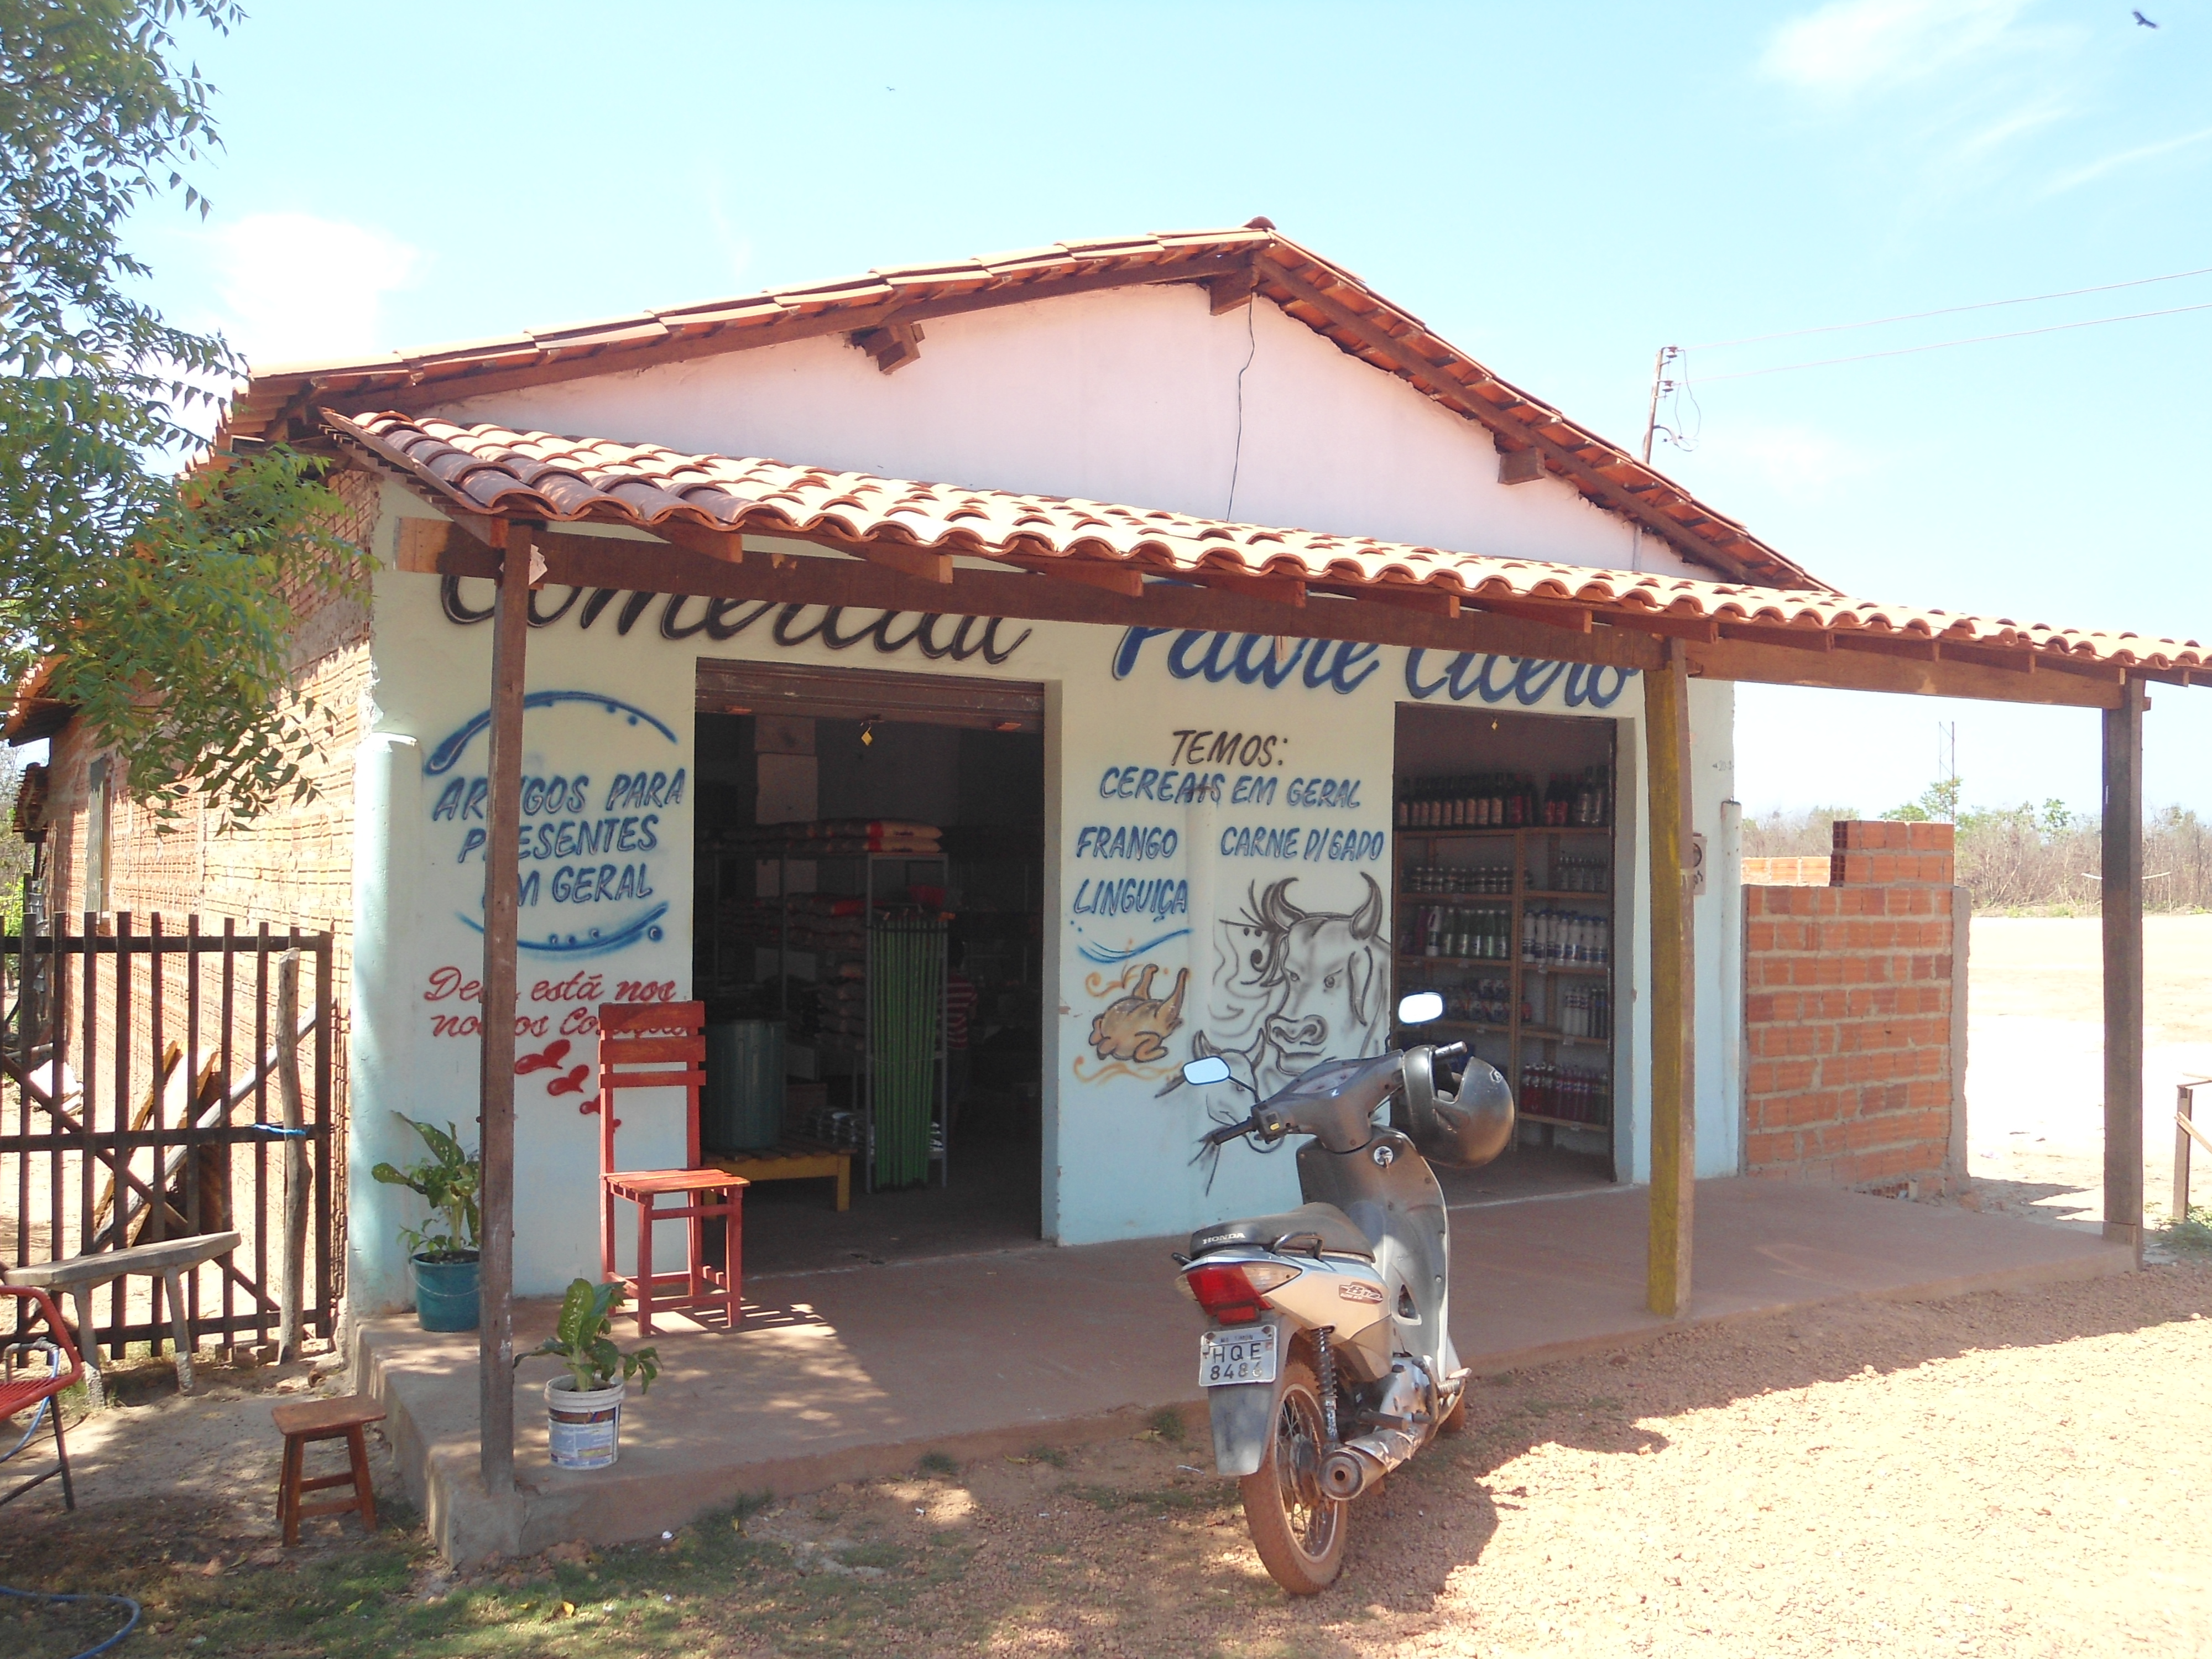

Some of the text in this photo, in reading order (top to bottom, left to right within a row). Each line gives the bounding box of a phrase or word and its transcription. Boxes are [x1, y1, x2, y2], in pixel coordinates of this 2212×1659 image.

[1172, 729, 1288, 767] TEMOS:
[432, 768, 686, 821] ARGOS PARA
[1099, 766, 1361, 808] CEREAIS EM GERAL
[458, 815, 659, 863] PESENTES
[1076, 826, 1179, 861] FRANGO
[1220, 827, 1300, 859] CARNE
[482, 863, 653, 909] M GERAL
[1073, 878, 1188, 922] LINGUIÇA
[424, 966, 521, 1001] De
[431, 1014, 549, 1037] noos
[1202, 1232, 1246, 1245] HONDA
[1213, 1342, 1261, 1363] HQE
[1209, 1360, 1262, 1381] 8486
